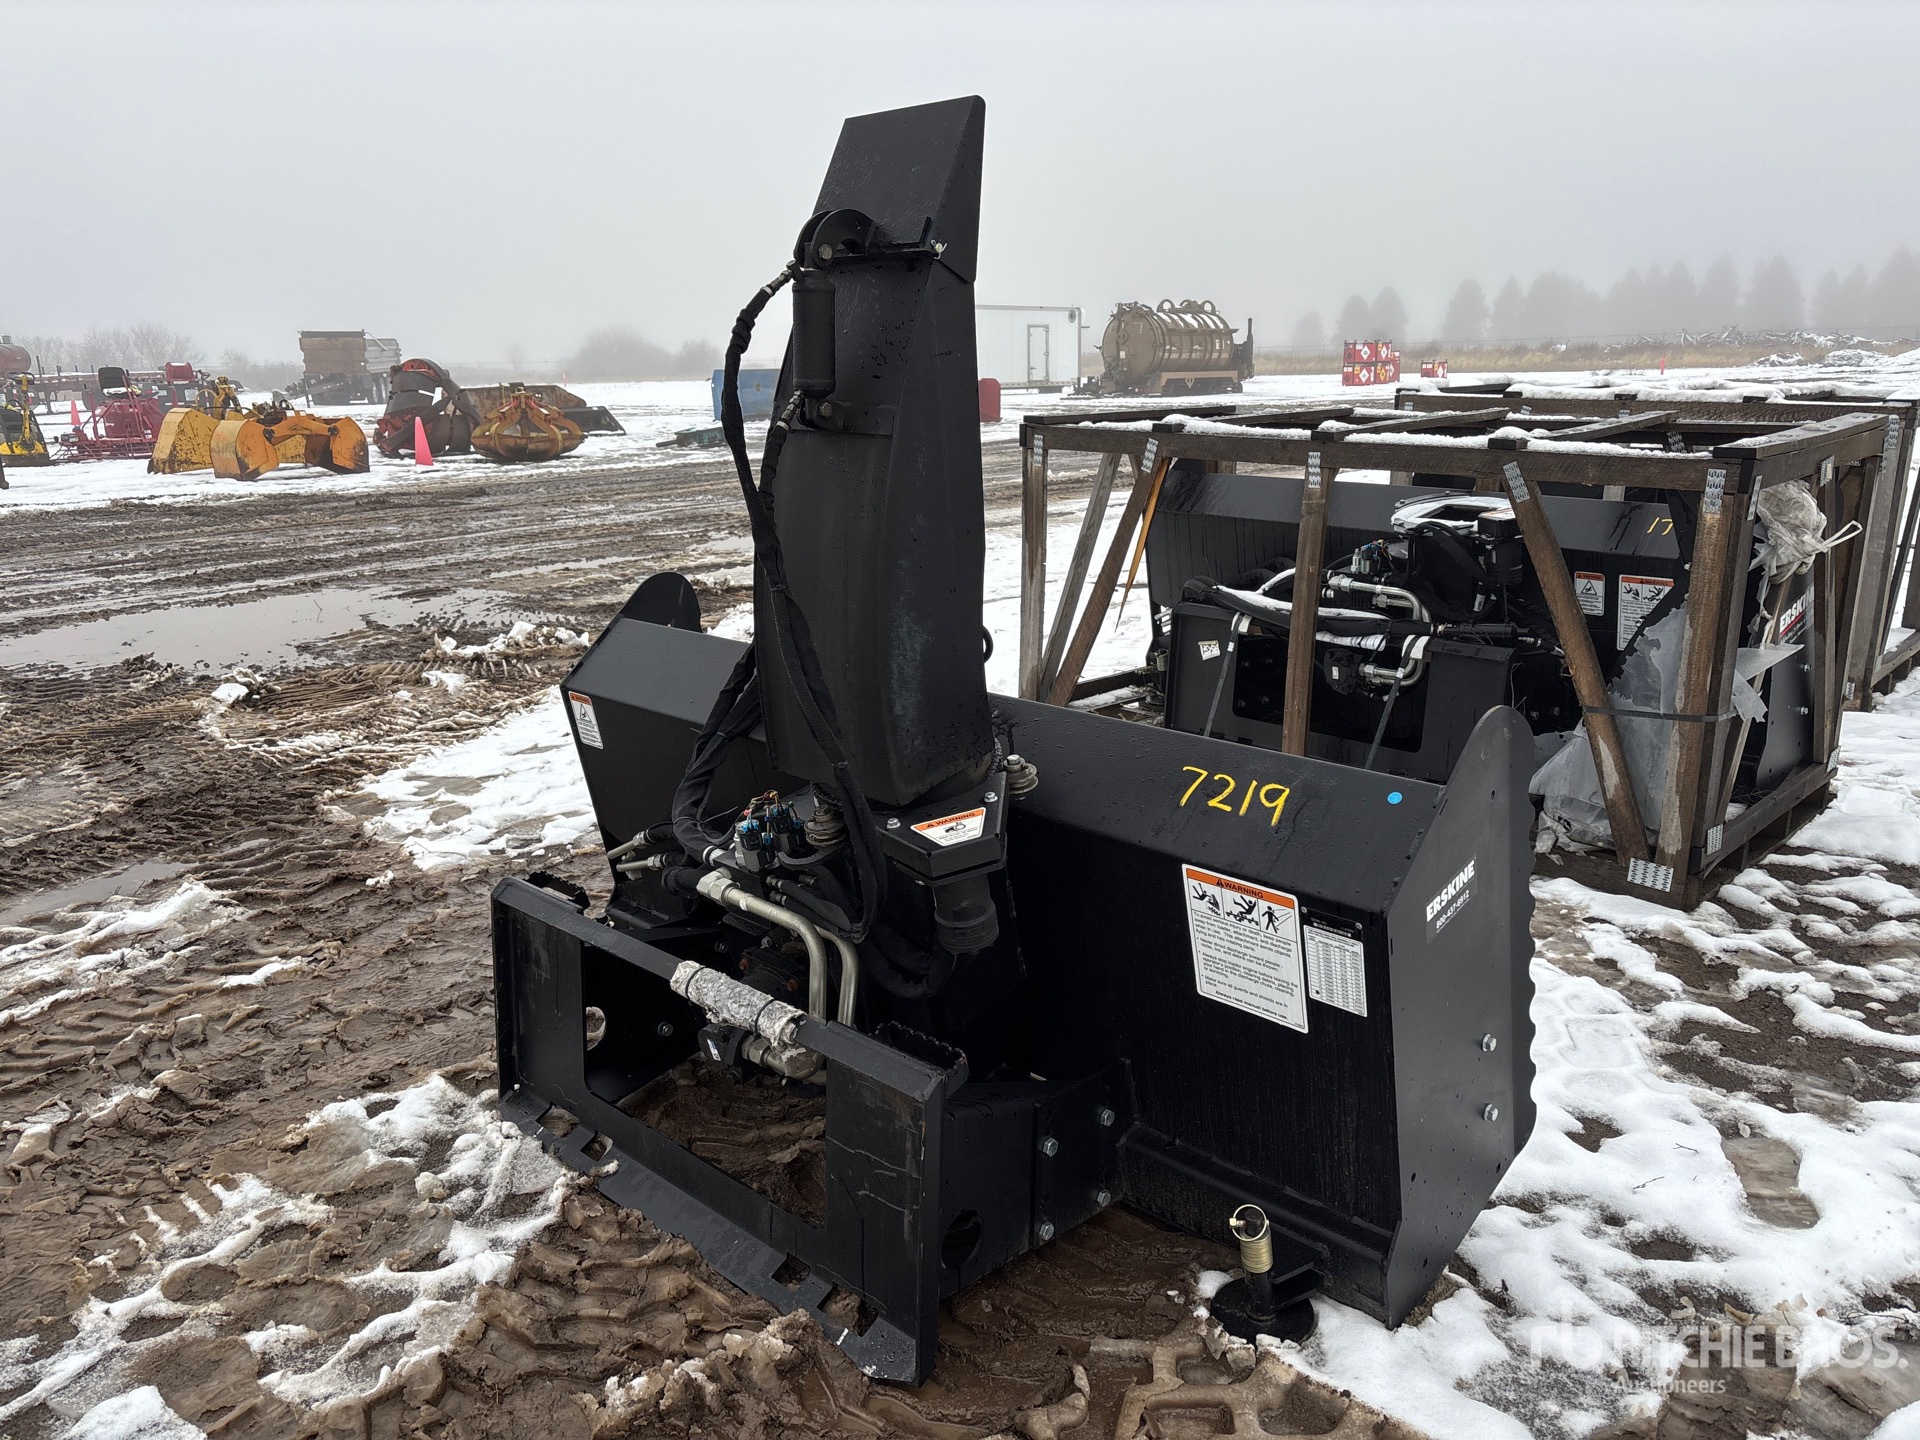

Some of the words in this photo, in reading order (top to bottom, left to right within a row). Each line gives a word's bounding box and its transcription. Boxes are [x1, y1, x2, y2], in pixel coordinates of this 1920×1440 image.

[1780, 586, 1814, 634] ERSKIN
[936, 812, 976, 825] WARNING
[1180, 766, 1290, 826] 7219
[1224, 882, 1264, 899] WARNING
[1426, 860, 1475, 922] ERSKINE
